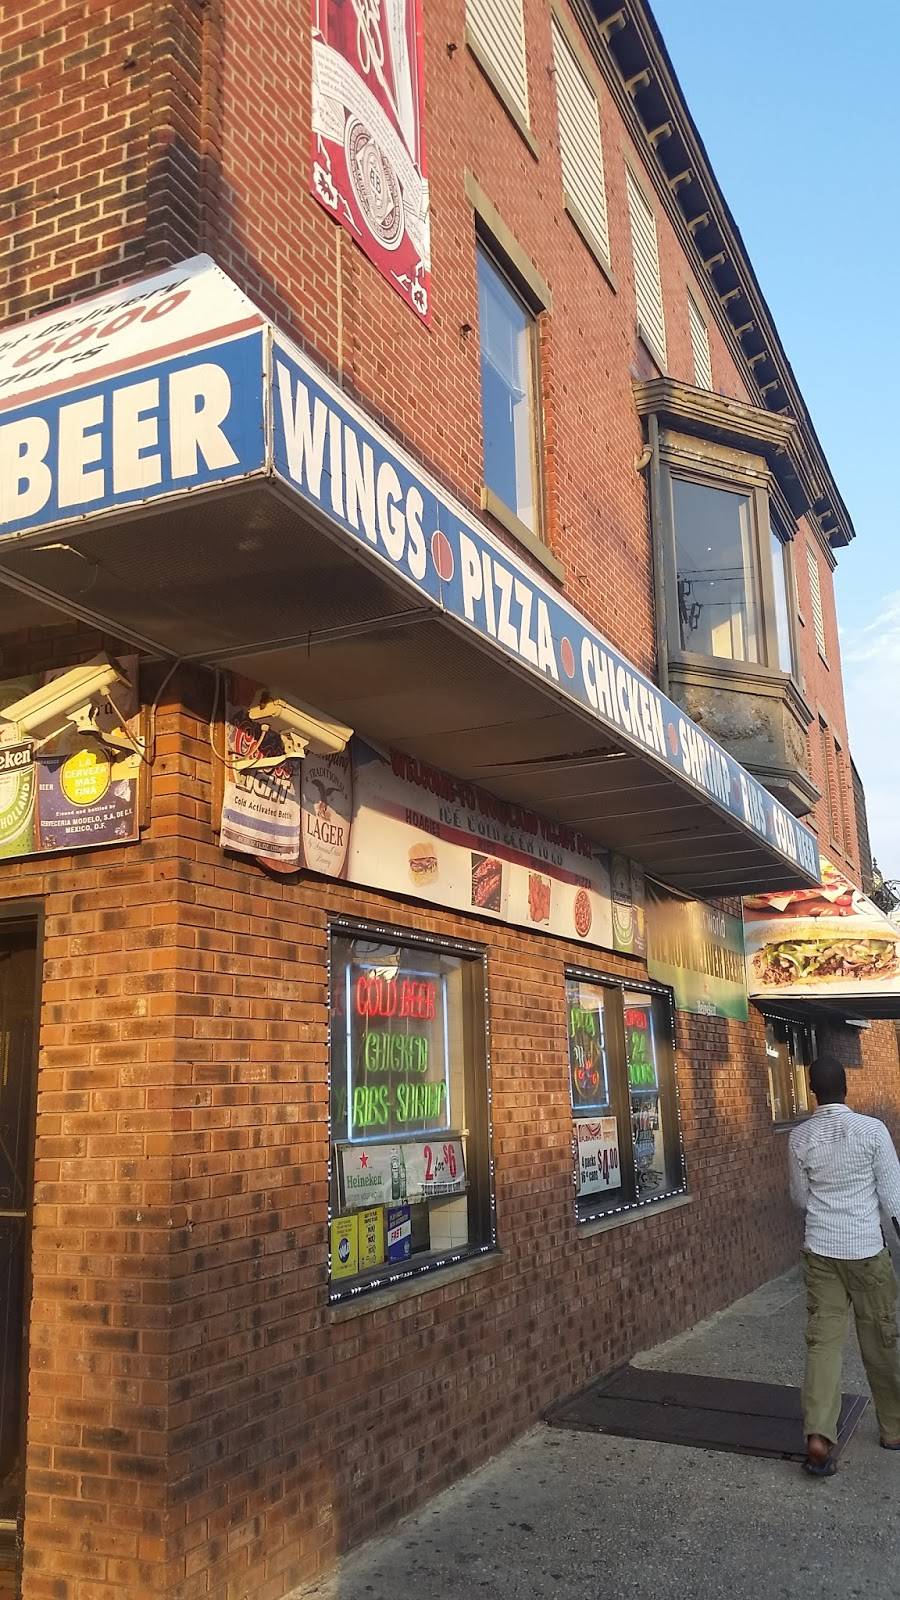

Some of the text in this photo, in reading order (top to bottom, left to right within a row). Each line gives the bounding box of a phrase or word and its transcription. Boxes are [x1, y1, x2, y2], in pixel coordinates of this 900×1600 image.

[33, 277, 191, 340] Delivery
[0, 362, 241, 525] BEER
[276, 360, 427, 580] WINGS
[460, 532, 560, 681] PIZZA
[581, 637, 667, 757] CHICKEN
[679, 718, 731, 806] SHRIMP
[740, 773, 767, 836] RIBS
[773, 804, 798, 860] COLD
[235, 796, 247, 807] Cold
[248, 801, 278, 818] Activated
[405, 808, 441, 835] HOAGIES
[440, 808, 462, 829] ICE
[65, 823, 93, 833] MEXICO,
[306, 813, 345, 847] LAGER
[356, 975, 438, 1022] COLD BEER
[365, 1032, 428, 1073] CHICKEN
[352, 1081, 450, 1127] RIBS SHRIMP
[346, 1171, 383, 1189] Heineken
[423, 1144, 434, 1180] 2
[443, 1144, 457, 1178] $6
